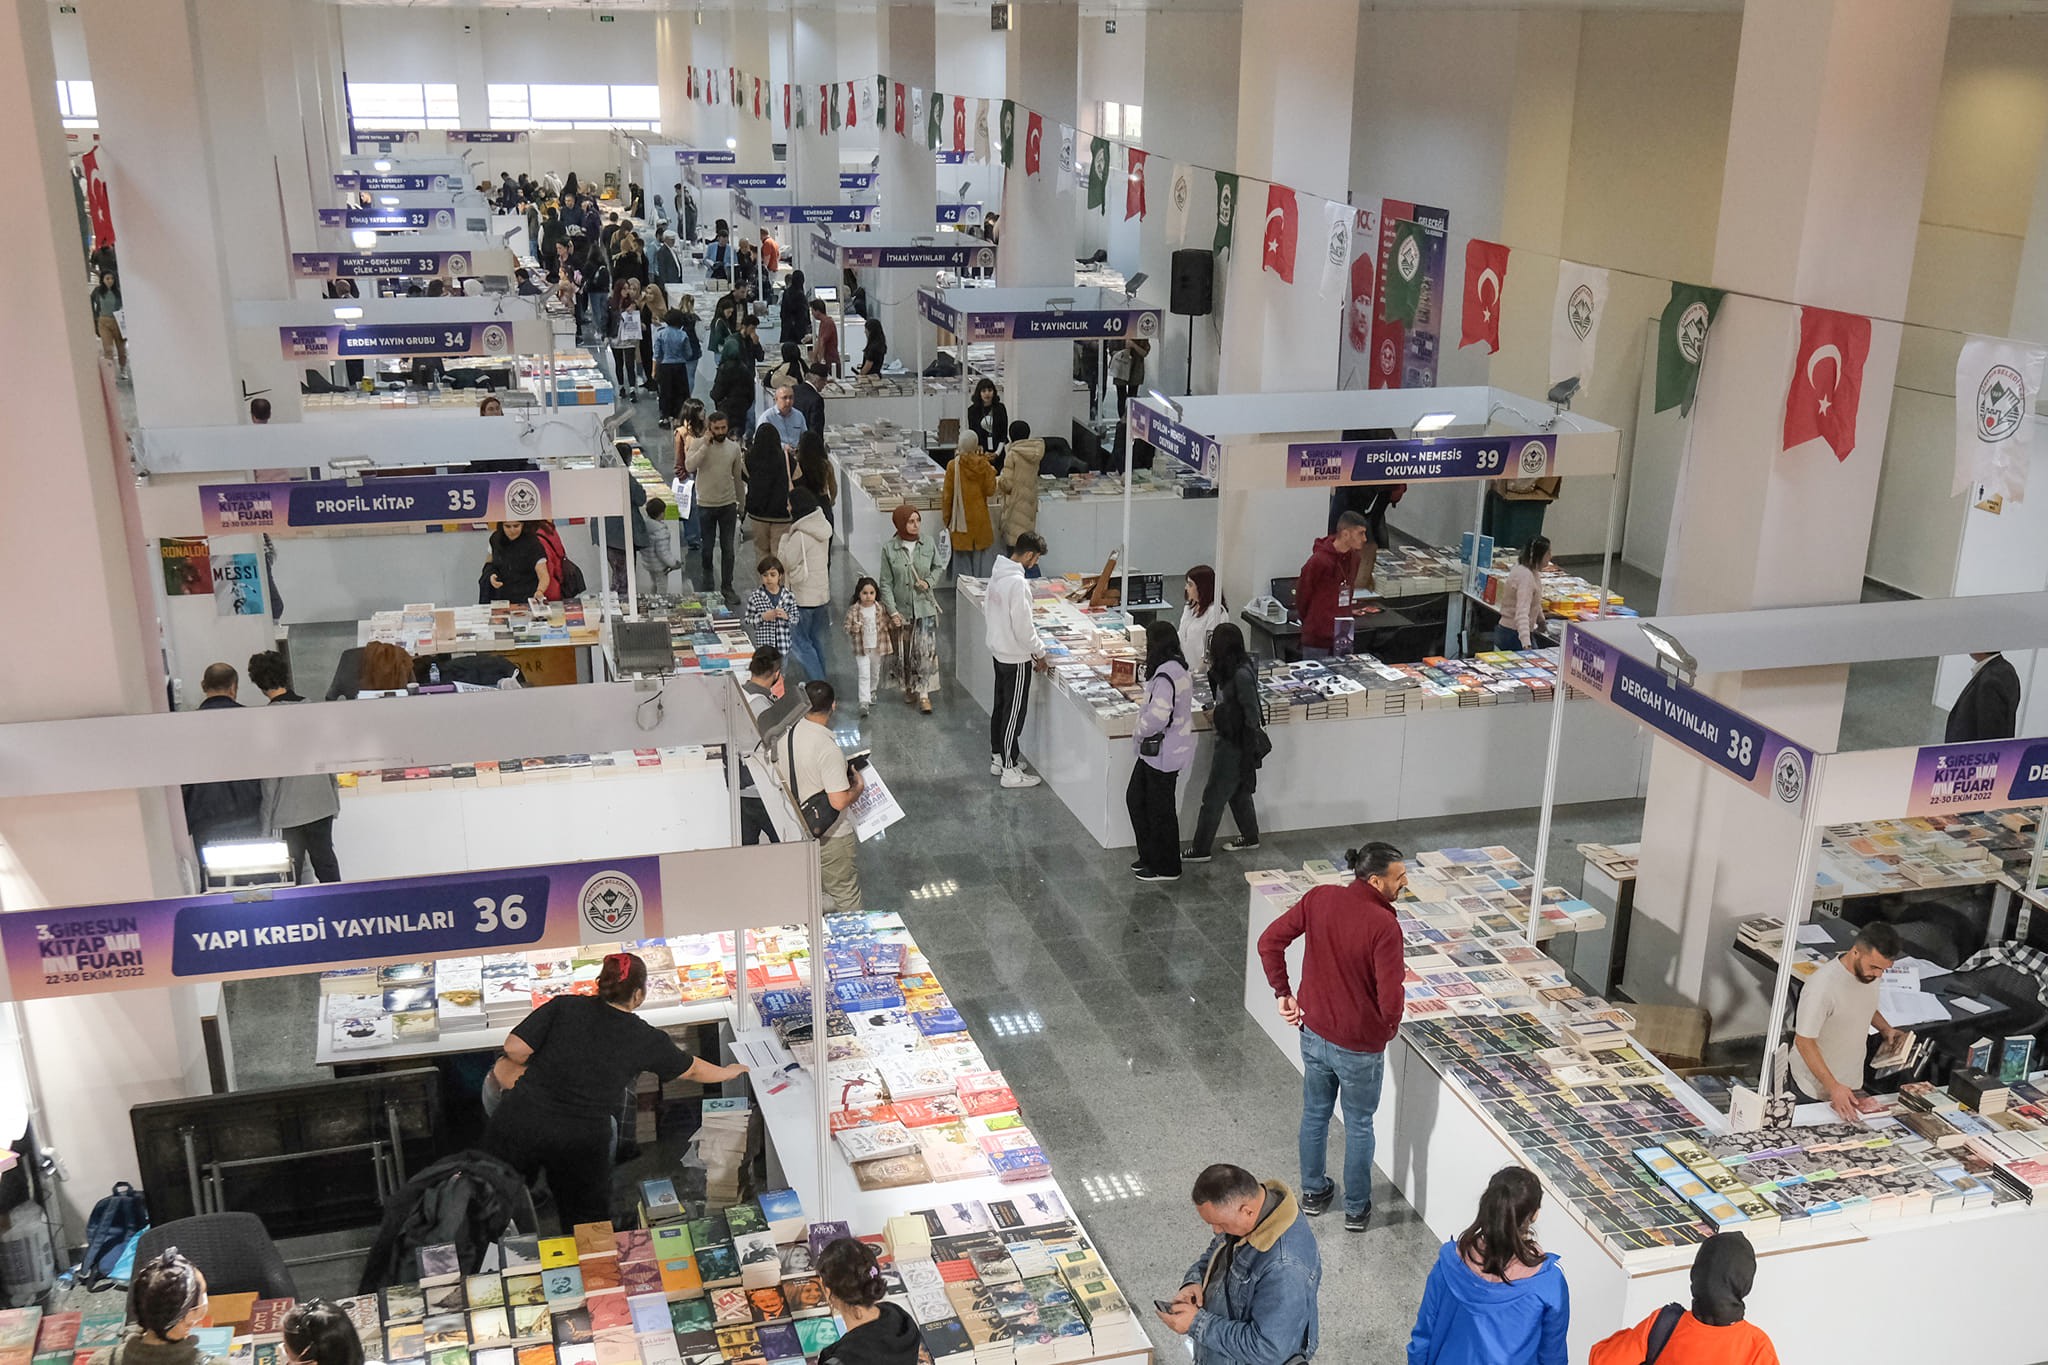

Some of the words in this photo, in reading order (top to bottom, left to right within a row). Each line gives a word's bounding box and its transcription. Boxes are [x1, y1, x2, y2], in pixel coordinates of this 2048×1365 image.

[416, 179, 424, 188] 31
[856, 178, 867, 186] 45
[351, 216, 368, 224] TİMAŞ
[412, 214, 424, 224] 32
[849, 210, 860, 220] 43
[944, 210, 956, 220] 42
[370, 259, 390, 267] GENÇ
[886, 252, 910, 262] İTHAKİ
[910, 254, 946, 262] YAYINLARI
[952, 252, 964, 263] 41
[354, 266, 373, 275] ÇİLEK
[419, 260, 434, 271] 33
[1030, 318, 1040, 331] İZ
[1041, 321, 1088, 331] YAYINCILIK
[1103, 318, 1122, 332] 40
[347, 338, 378, 347] ERDEM
[378, 336, 404, 346] YAYIN
[406, 336, 435, 346] GRUBU
[444, 332, 464, 347] 34
[1190, 441, 1200, 462] 39
[1366, 450, 1410, 463] EPSİLON
[1419, 448, 1462, 461] NEMESİS
[1476, 449, 1499, 469] 39
[1314, 466, 1341, 475] FUARI
[1385, 466, 1426, 476] OKUYAN
[1428, 465, 1442, 474] US
[218, 501, 254, 512] KİTAP
[316, 498, 370, 513] PROFİL
[373, 493, 415, 510] KİTAP
[447, 489, 476, 511] 35
[238, 510, 273, 520] FUARI
[161, 545, 208, 558] RONALDO
[213, 565, 258, 581] MESSI
[1582, 660, 1604, 684] FUARI
[1621, 675, 1662, 712] DERGAH
[1663, 698, 1719, 744] YAYINLARI
[1726, 729, 1753, 767] 38
[1934, 767, 1977, 782] KİTAP
[1952, 779, 1995, 794] FUARI
[1930, 796, 1951, 804] 22-30
[1952, 794, 1972, 802] EKİM
[1973, 792, 1992, 800] 2022
[192, 932, 248, 950] YAPI
[254, 917, 326, 946] KREDİ
[332, 910, 454, 938] YAYINLARI
[473, 894, 527, 933] 36
[38, 936, 106, 957] KİTAP
[76, 950, 143, 970] FUARI
[45, 974, 80, 984] 22-30
[82, 970, 113, 981] EKİM
[116, 967, 145, 978] 2022
